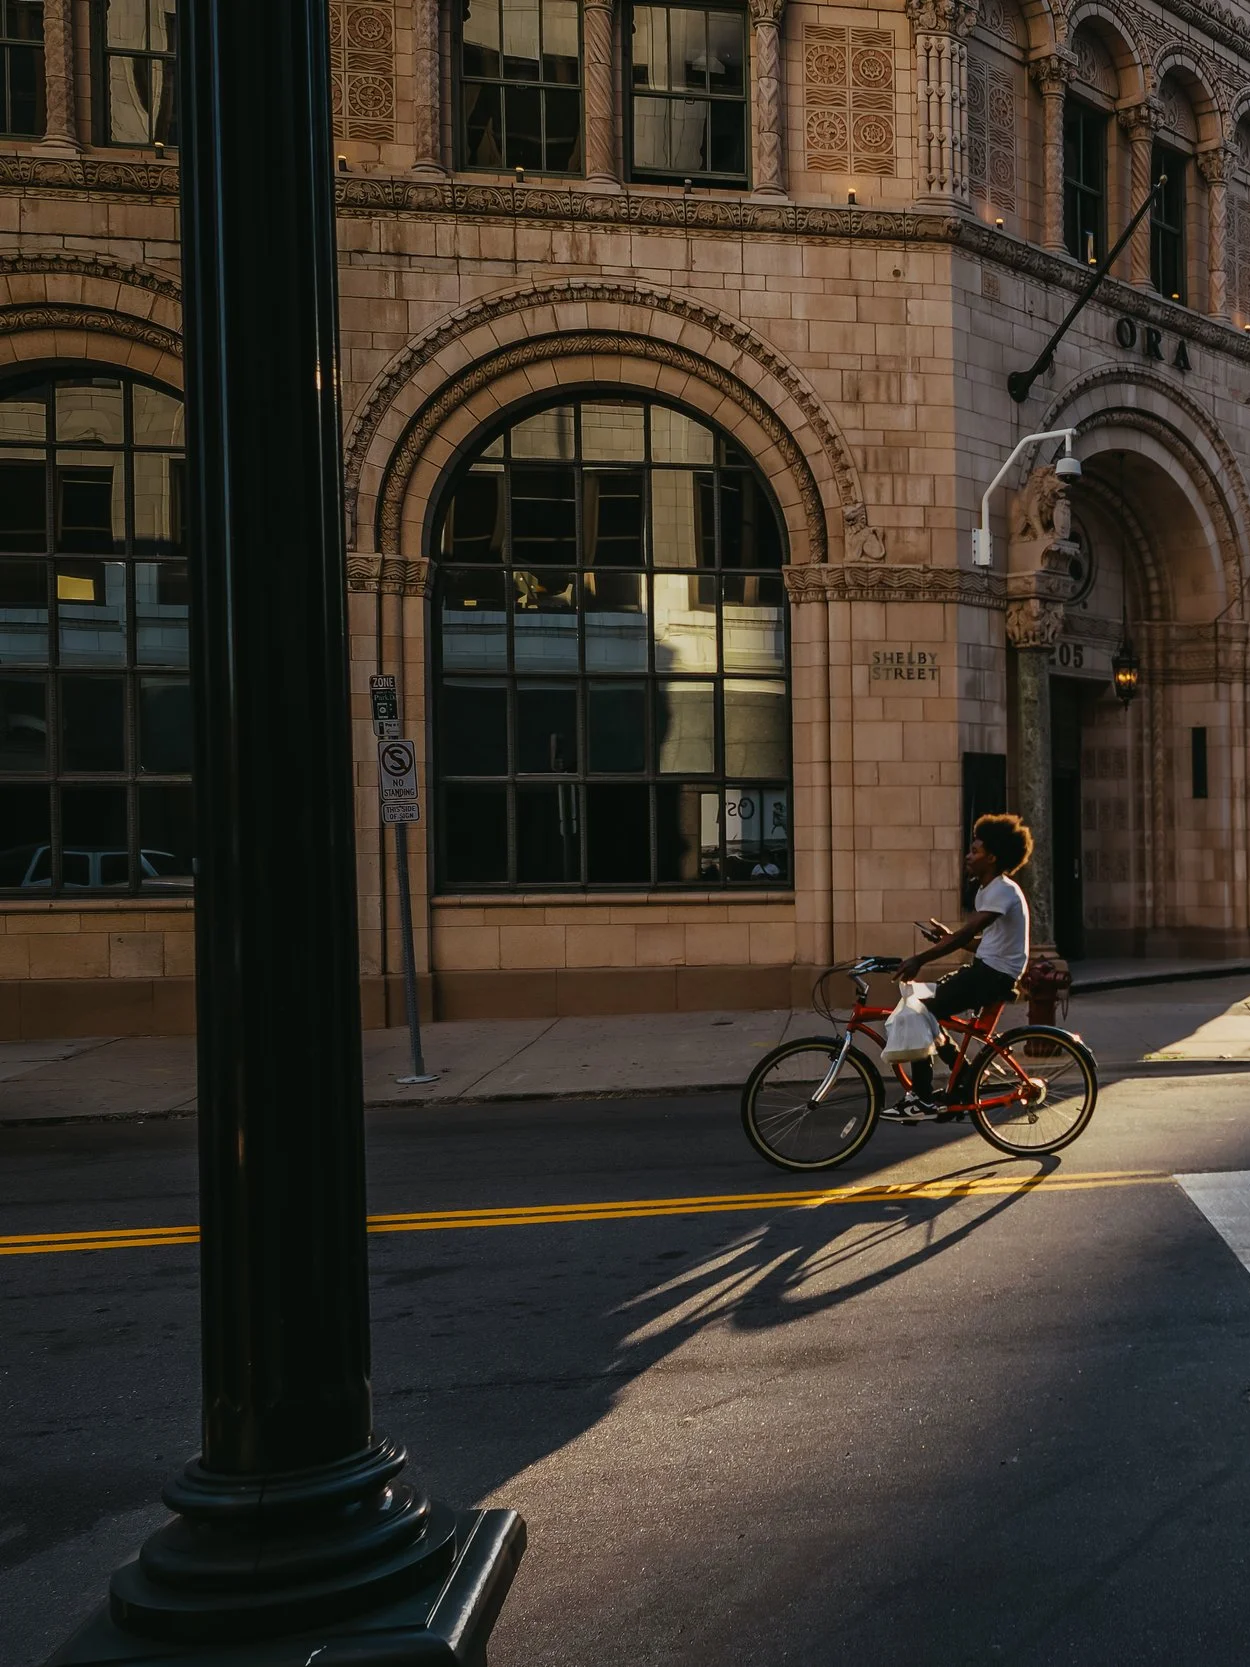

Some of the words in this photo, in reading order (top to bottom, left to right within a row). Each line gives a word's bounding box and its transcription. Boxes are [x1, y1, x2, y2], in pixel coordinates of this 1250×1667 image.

[1116, 317, 1192, 370] ORA
[872, 651, 938, 665] SHELBY
[872, 667, 938, 681] STREET
[372, 677, 394, 688] ZONE
[392, 779, 404, 787] NO
[384, 788, 415, 797] STANDING
[386, 806, 400, 814] THIS
